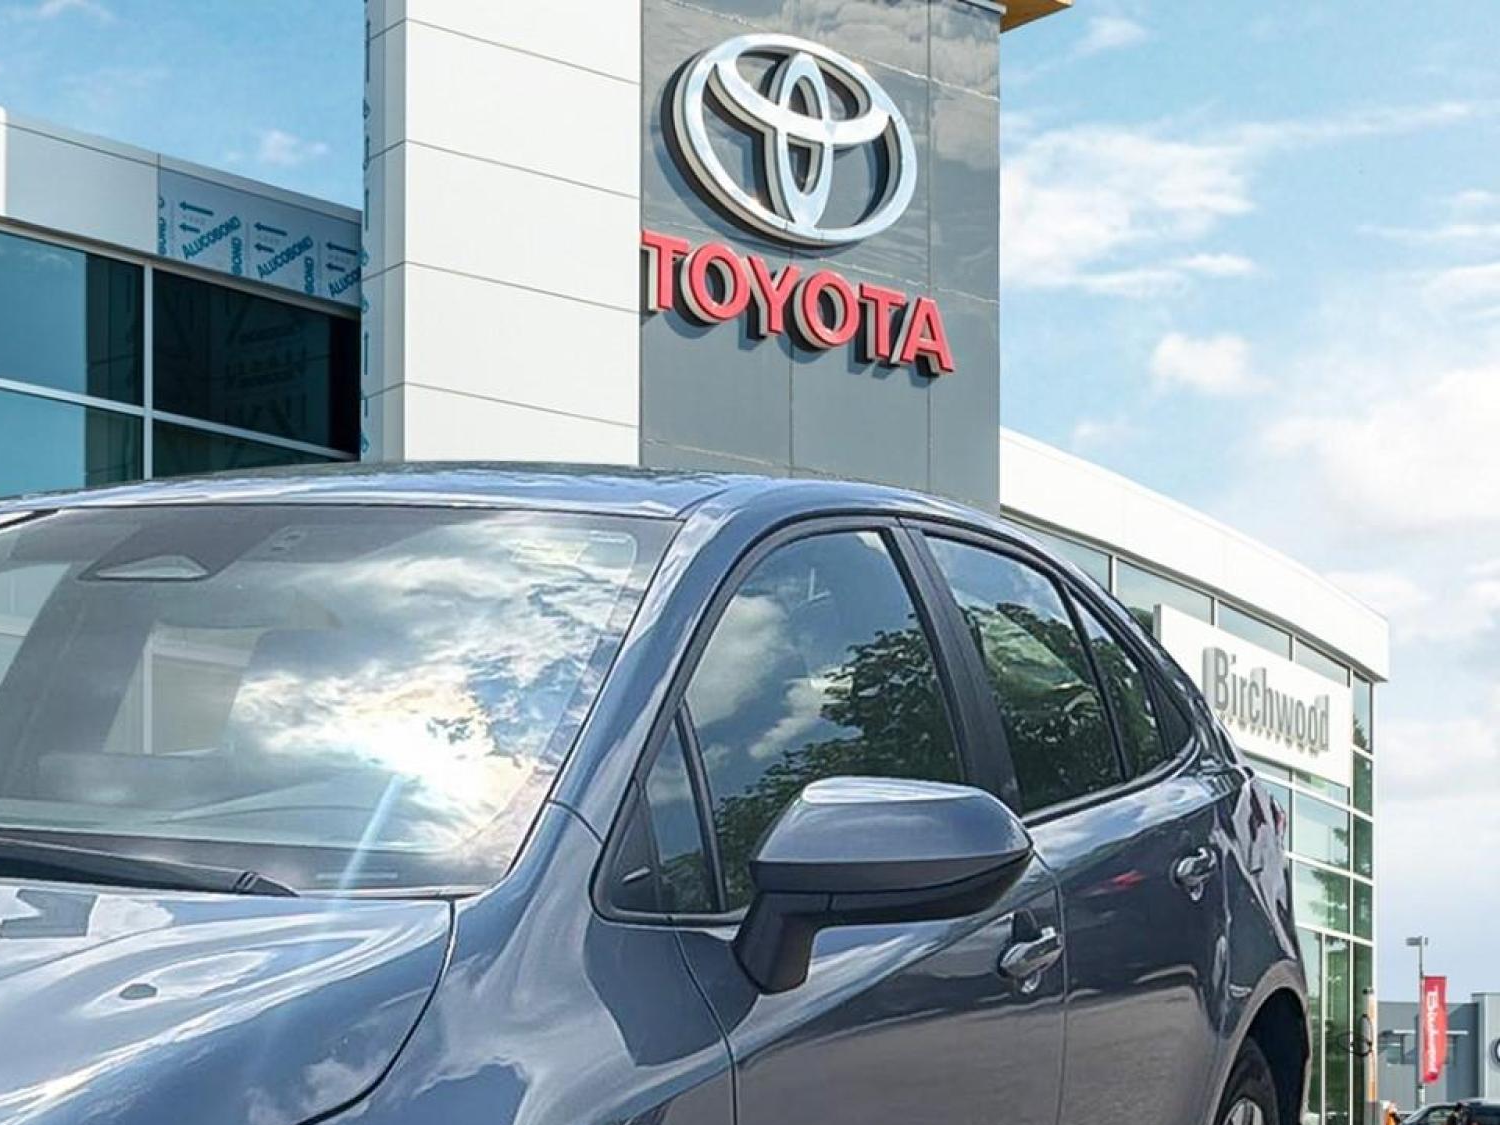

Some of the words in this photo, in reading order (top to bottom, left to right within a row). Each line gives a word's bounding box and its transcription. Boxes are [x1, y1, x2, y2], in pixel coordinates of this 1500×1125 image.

[182, 215, 241, 260] ALUCOBOND
[257, 235, 314, 279] ALUCOBOND
[641, 230, 955, 374] TOYOTA
[1203, 647, 1329, 754] Birchwood
